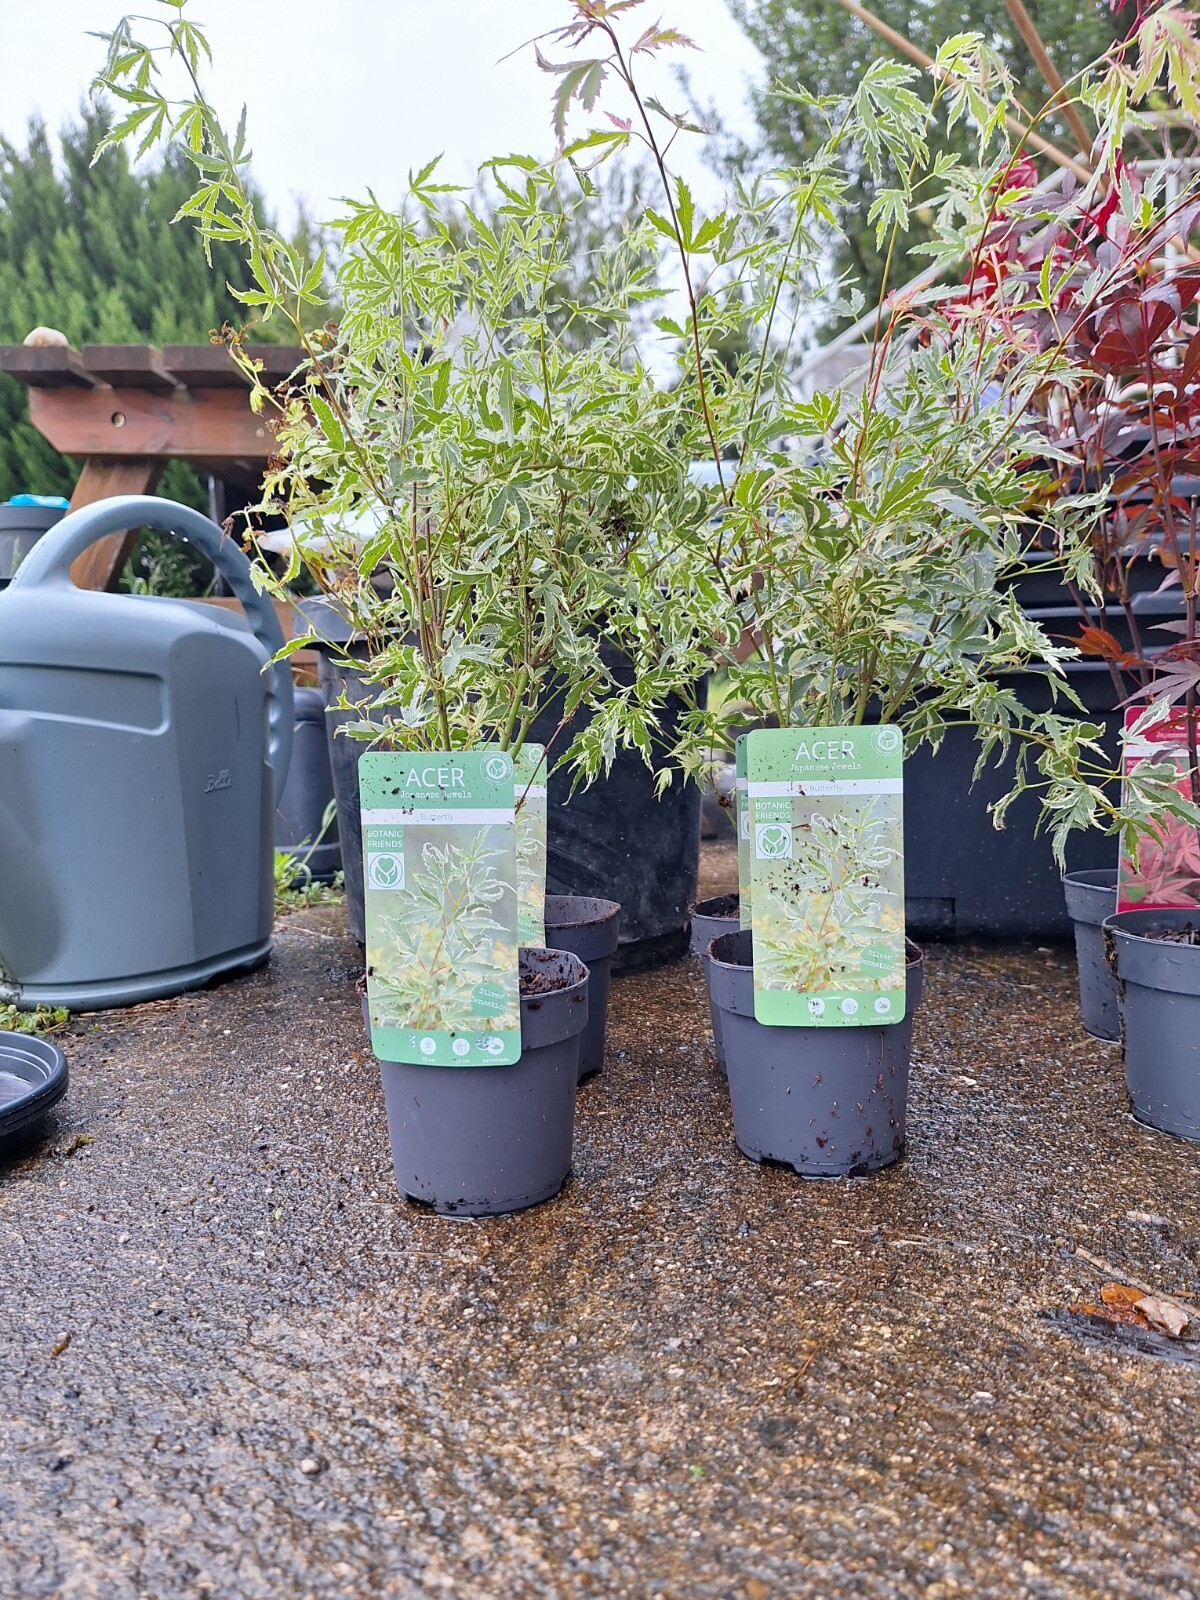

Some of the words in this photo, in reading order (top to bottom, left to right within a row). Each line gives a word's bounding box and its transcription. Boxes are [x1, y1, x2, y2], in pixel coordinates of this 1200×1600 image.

[795, 740, 856, 761] ACER
[789, 763, 830, 773] Japanese
[831, 762, 862, 771] Jewels
[405, 767, 466, 788] ACER
[809, 784, 843, 793] Butterfly
[400, 790, 440, 800] Japanese
[443, 790, 472, 799] Jewels
[755, 801, 791, 810] BOTANIC
[420, 813, 454, 822] Butterfly
[755, 811, 791, 820] FRIENDS
[367, 830, 402, 838] BOTANIC
[367, 840, 403, 848] FRIENDS
[867, 949, 892, 961] Silver
[859, 957, 896, 973] Sensation
[479, 987, 505, 1000] Silver
[470, 995, 508, 1011] Sensation
